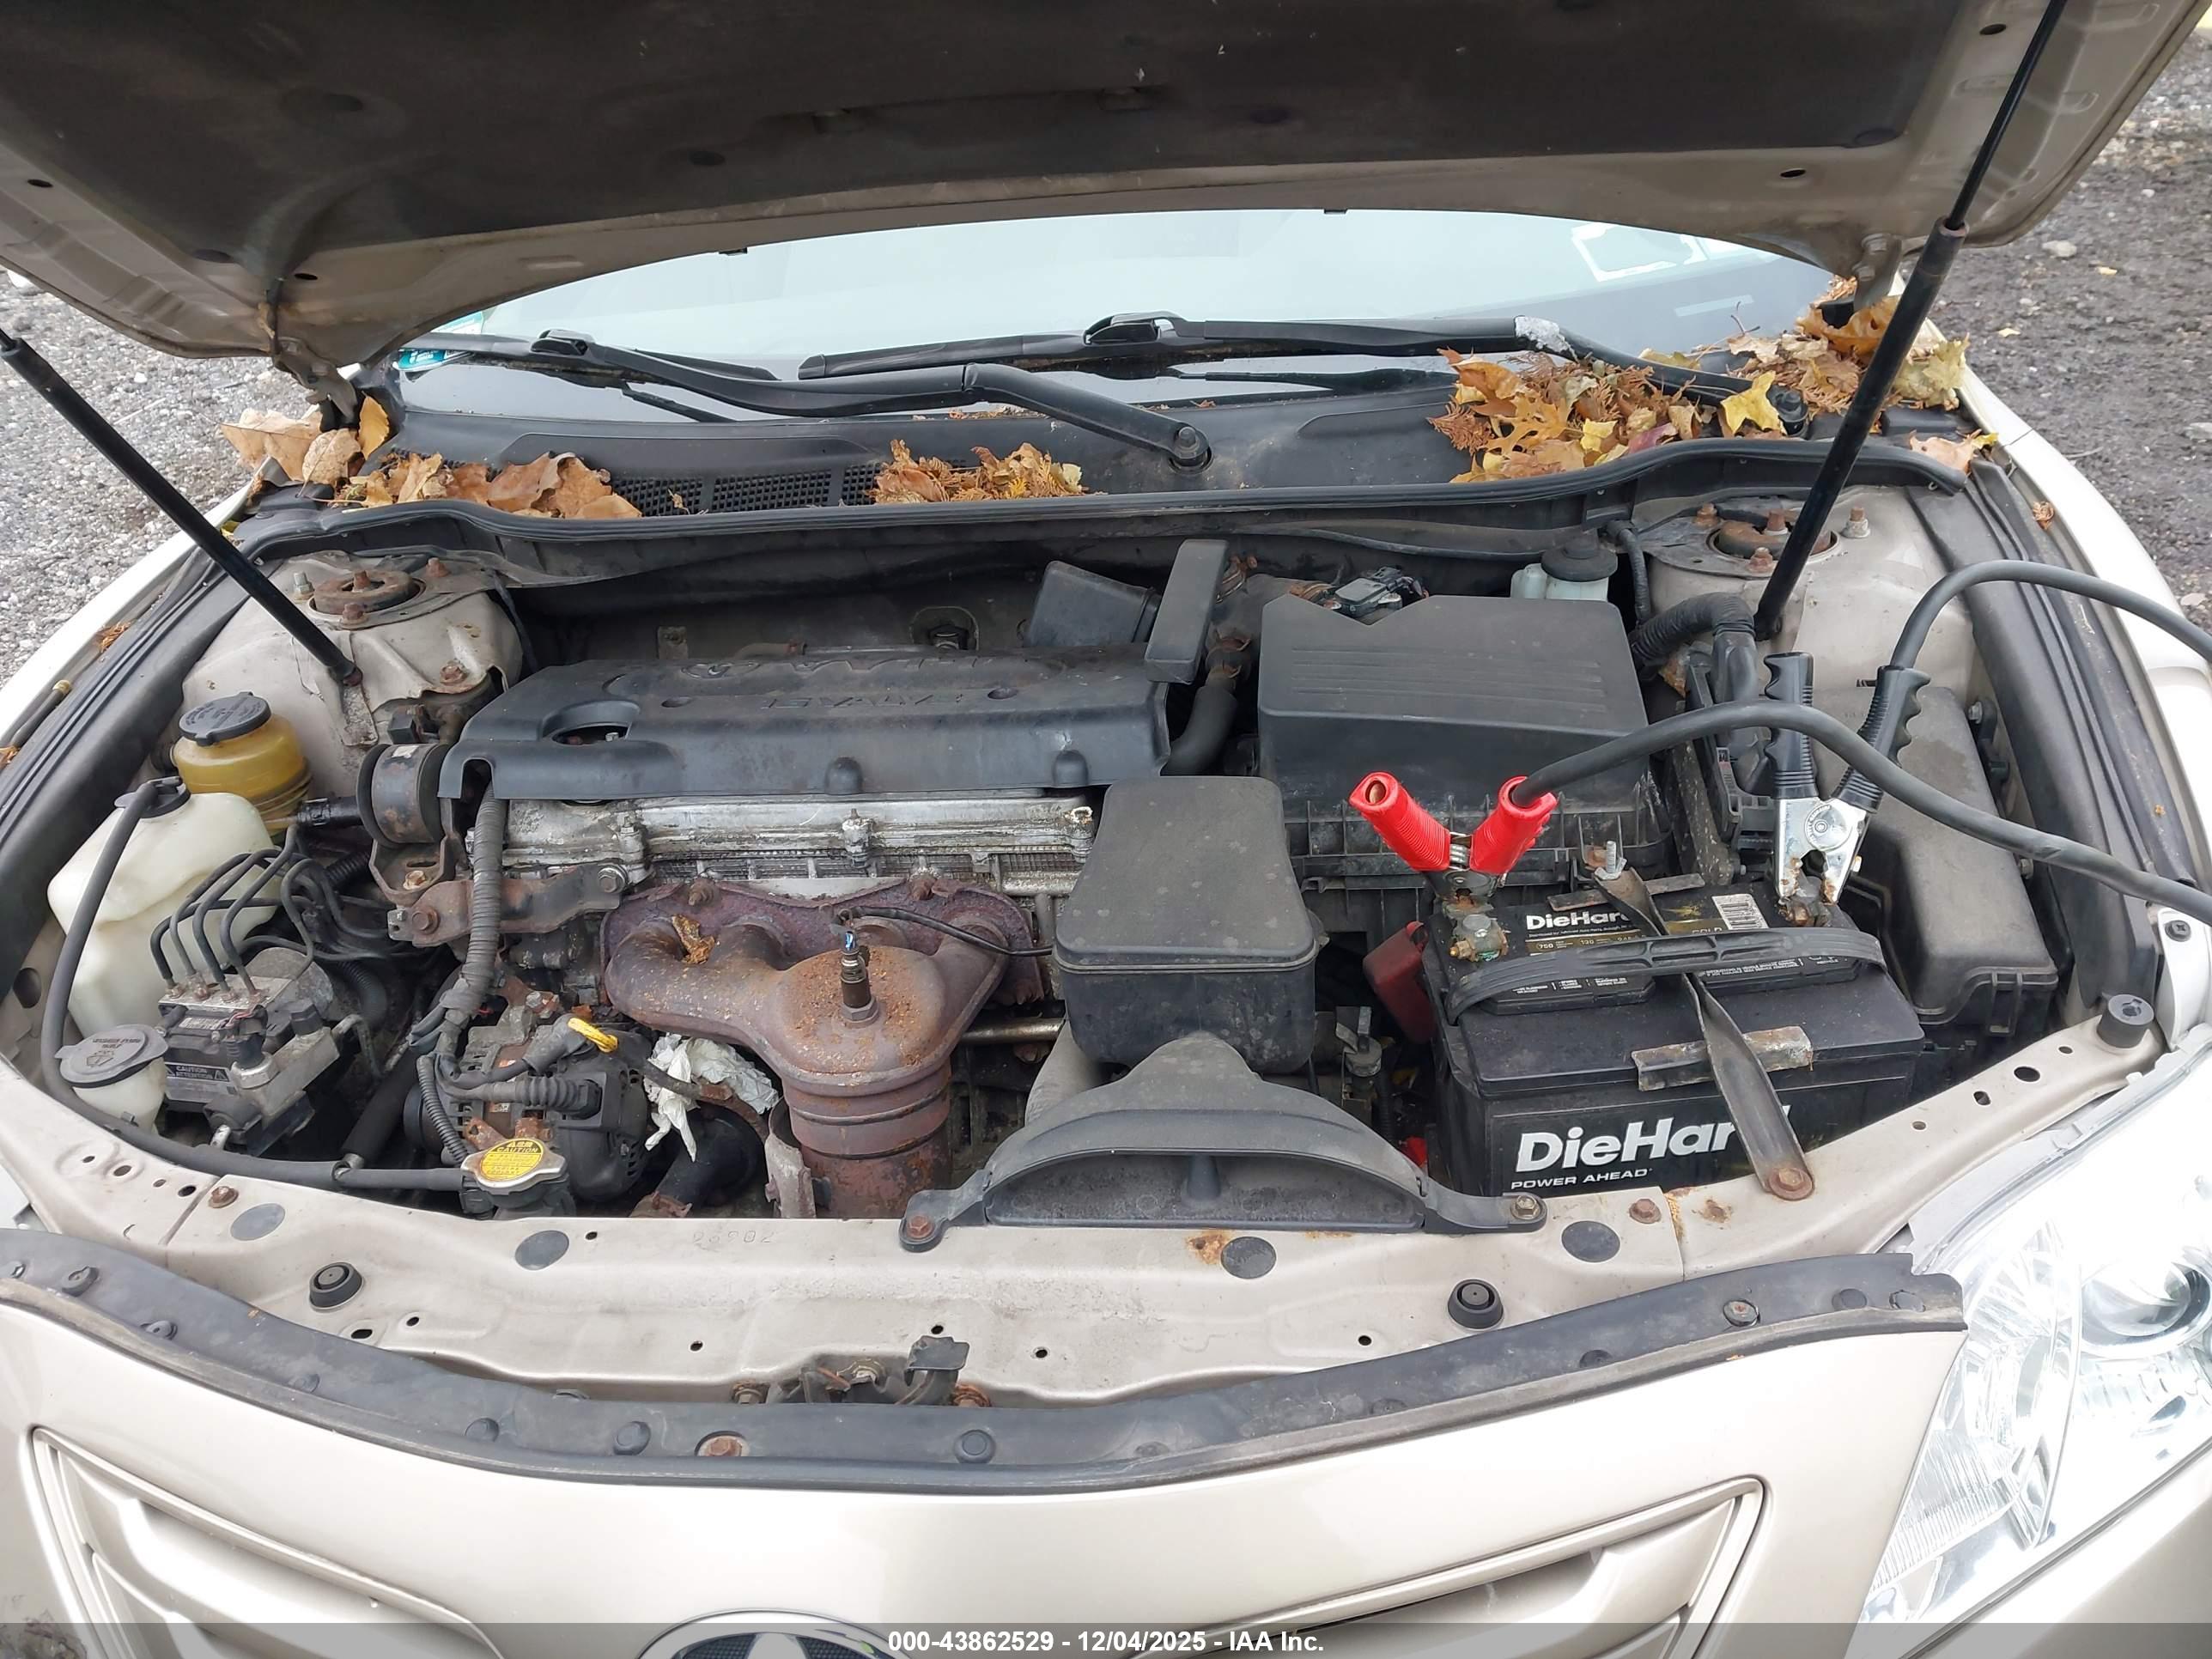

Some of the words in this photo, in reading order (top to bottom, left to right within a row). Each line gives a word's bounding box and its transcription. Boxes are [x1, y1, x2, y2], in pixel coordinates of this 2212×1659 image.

[1516, 1108, 1790, 1173] DieHar
[1510, 1176, 1577, 1190] POWER
[1582, 1169, 1649, 1184] AHEAD
